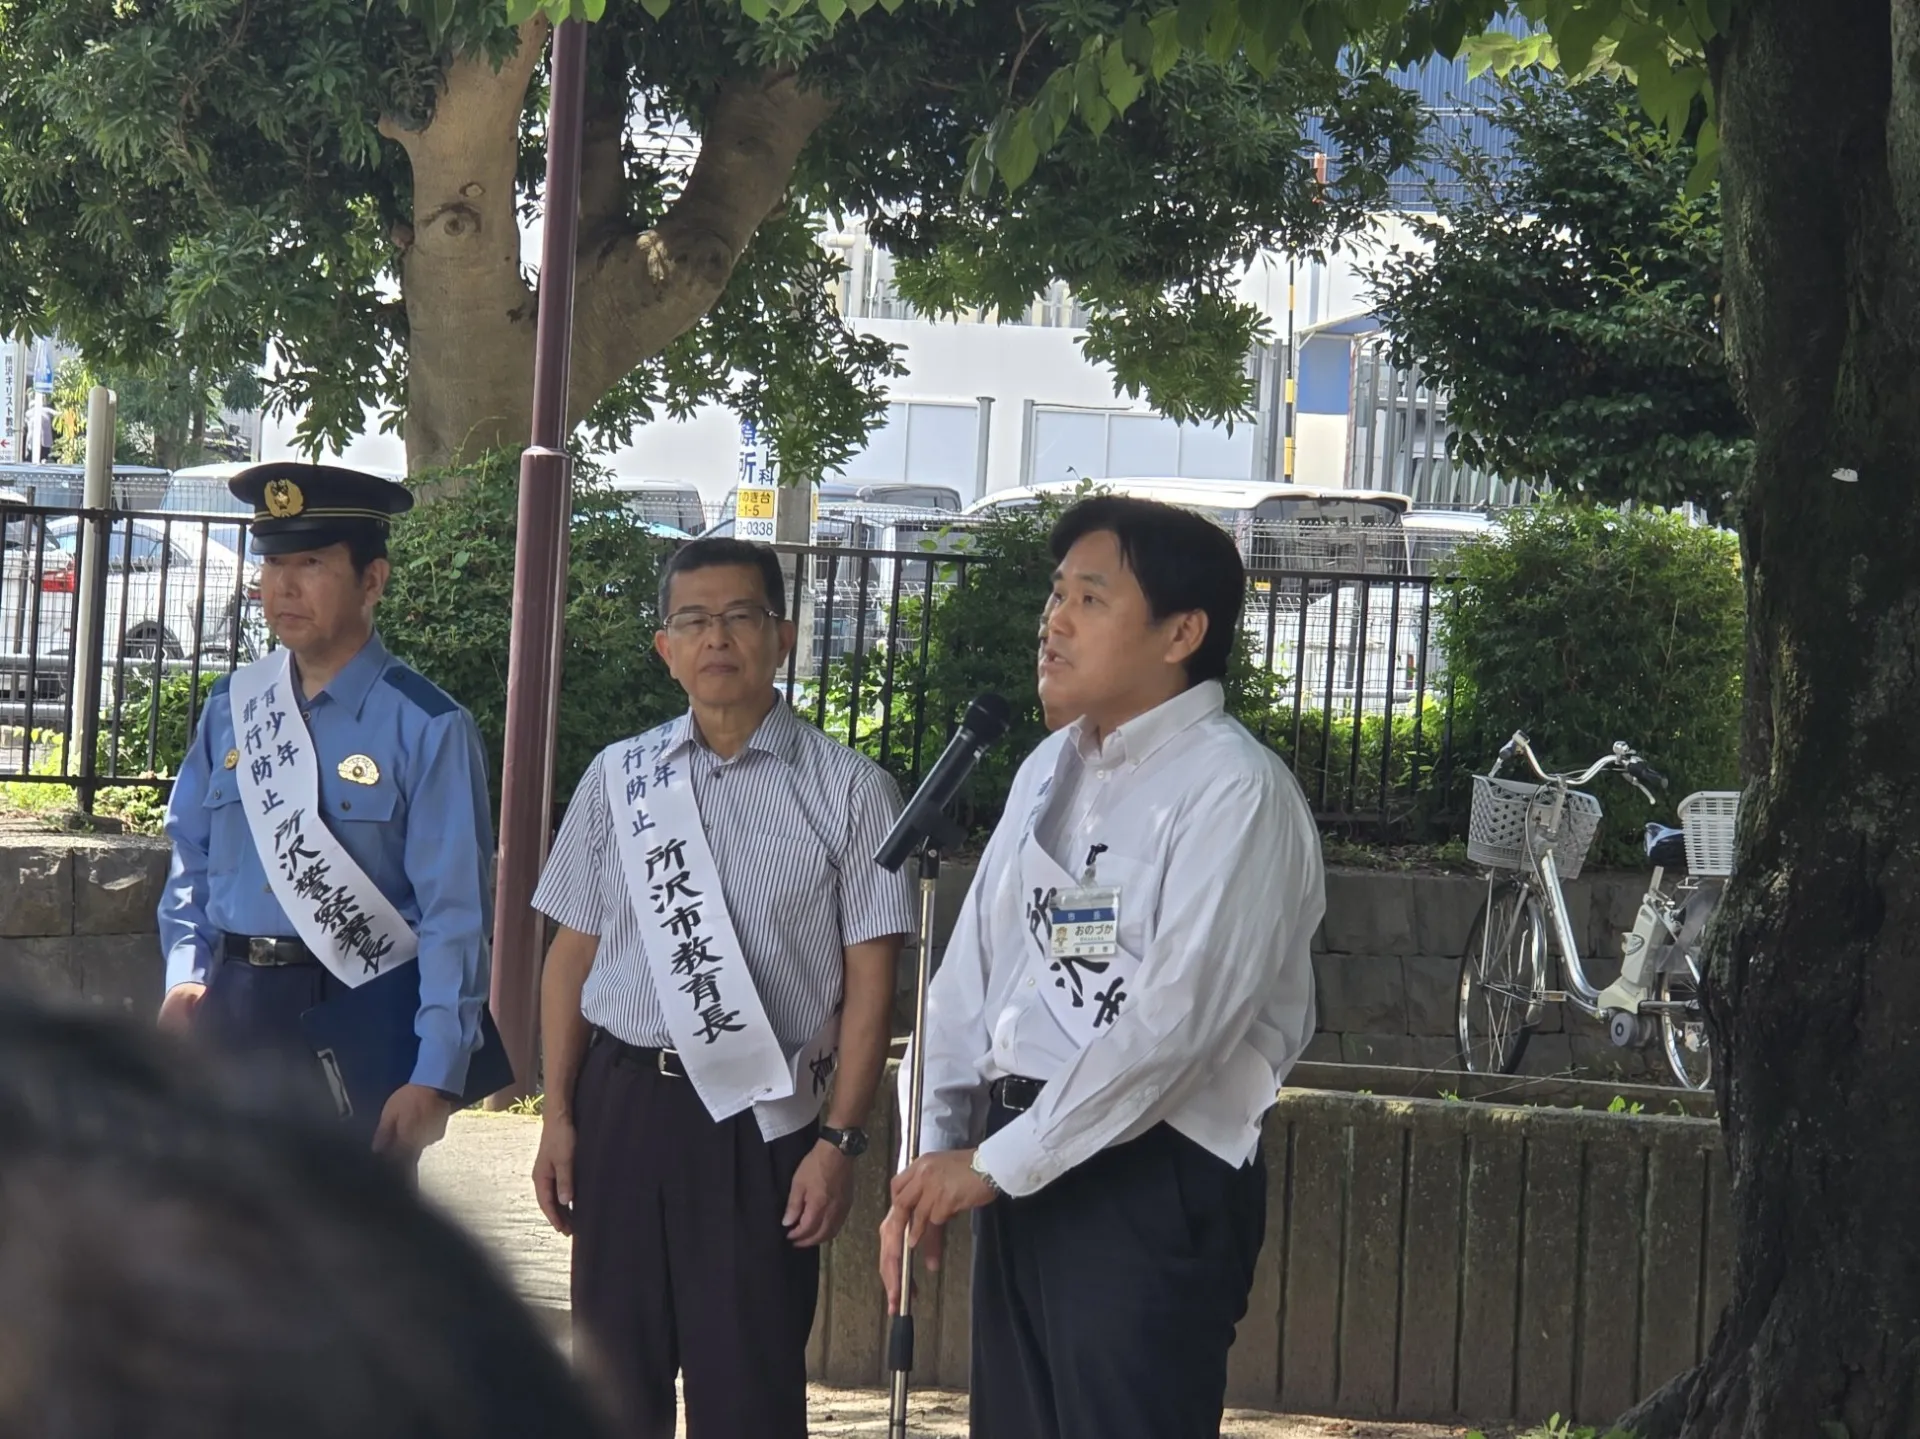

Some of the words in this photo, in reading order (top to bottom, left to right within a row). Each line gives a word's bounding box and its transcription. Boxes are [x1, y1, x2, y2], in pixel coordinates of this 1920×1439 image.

[243, 696, 284, 816] 非行防止
[622, 735, 656, 838] 行防止
[274, 808, 396, 975] 所沢警察署長
[645, 838, 747, 1045] 所沢市教育長
[1074, 924, 1114, 937] おのづか
